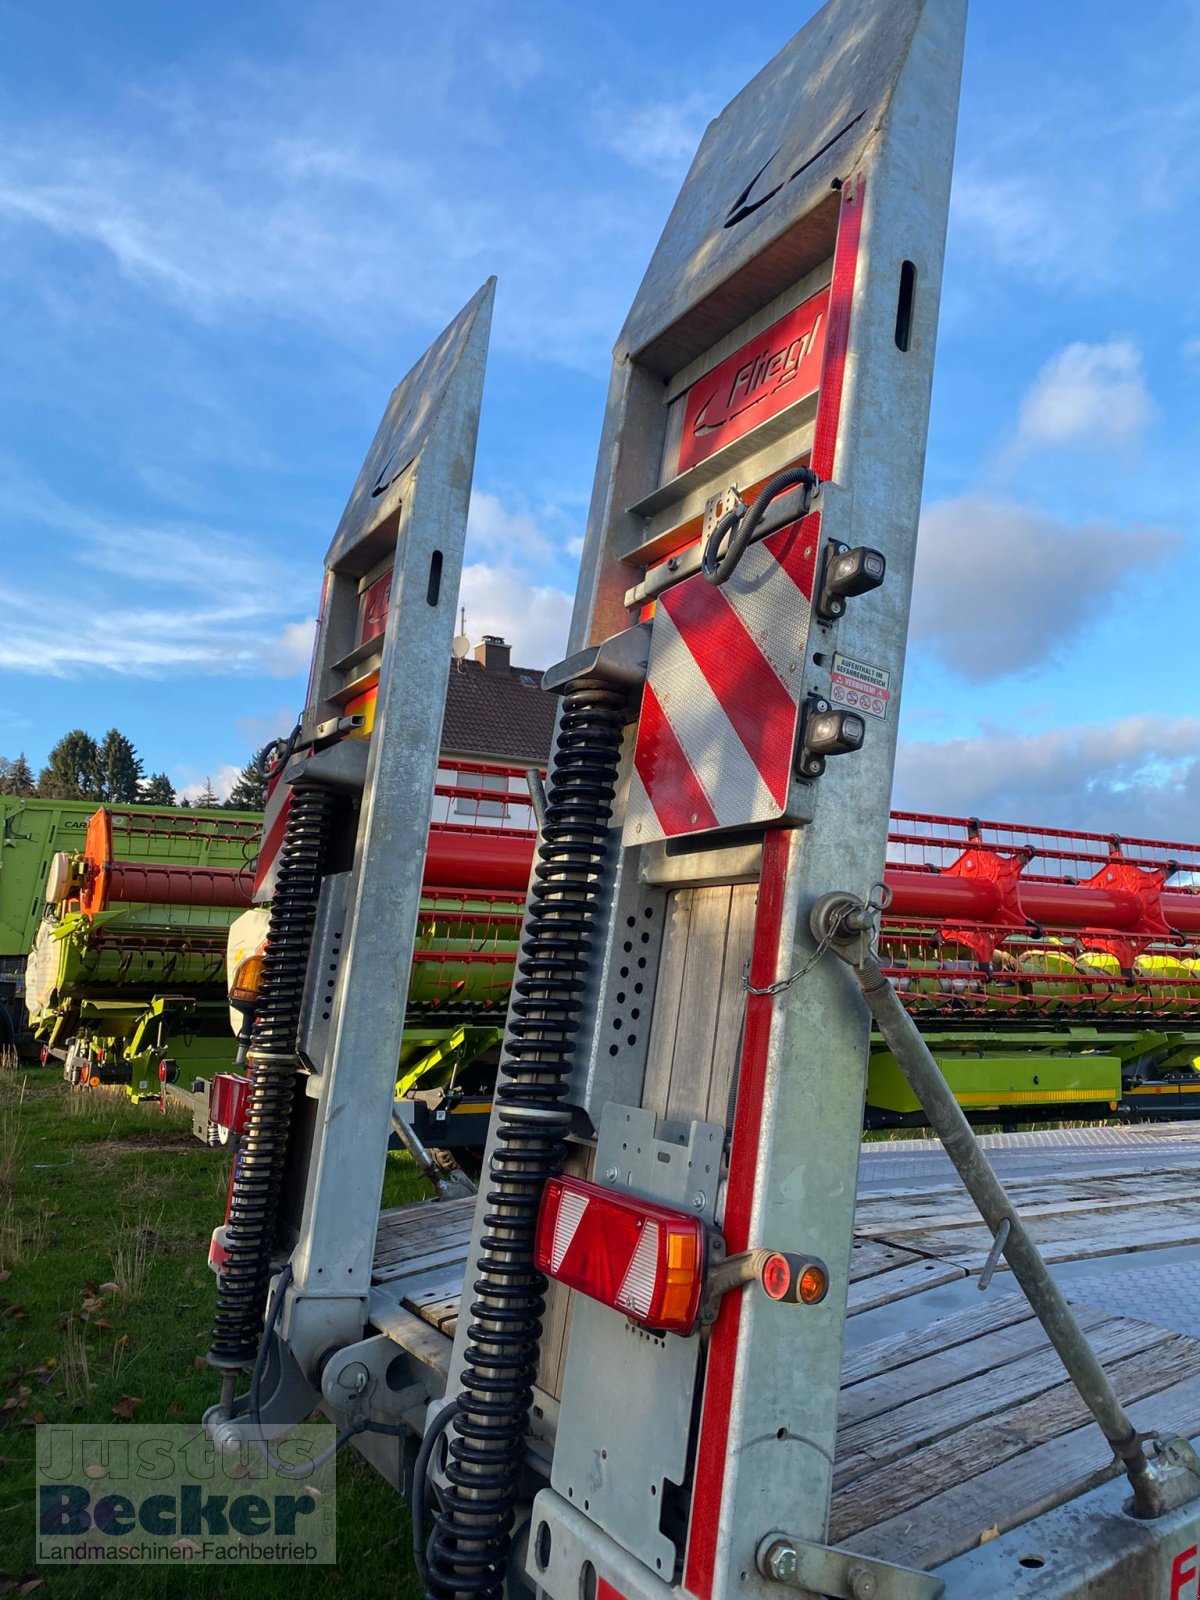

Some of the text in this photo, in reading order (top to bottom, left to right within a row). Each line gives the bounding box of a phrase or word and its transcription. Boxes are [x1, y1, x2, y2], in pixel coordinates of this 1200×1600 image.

[727, 312, 823, 408] Fliegl
[836, 664, 886, 687] GEFAHRENBEREICH
[841, 659, 883, 679] AUFENTHALT IM
